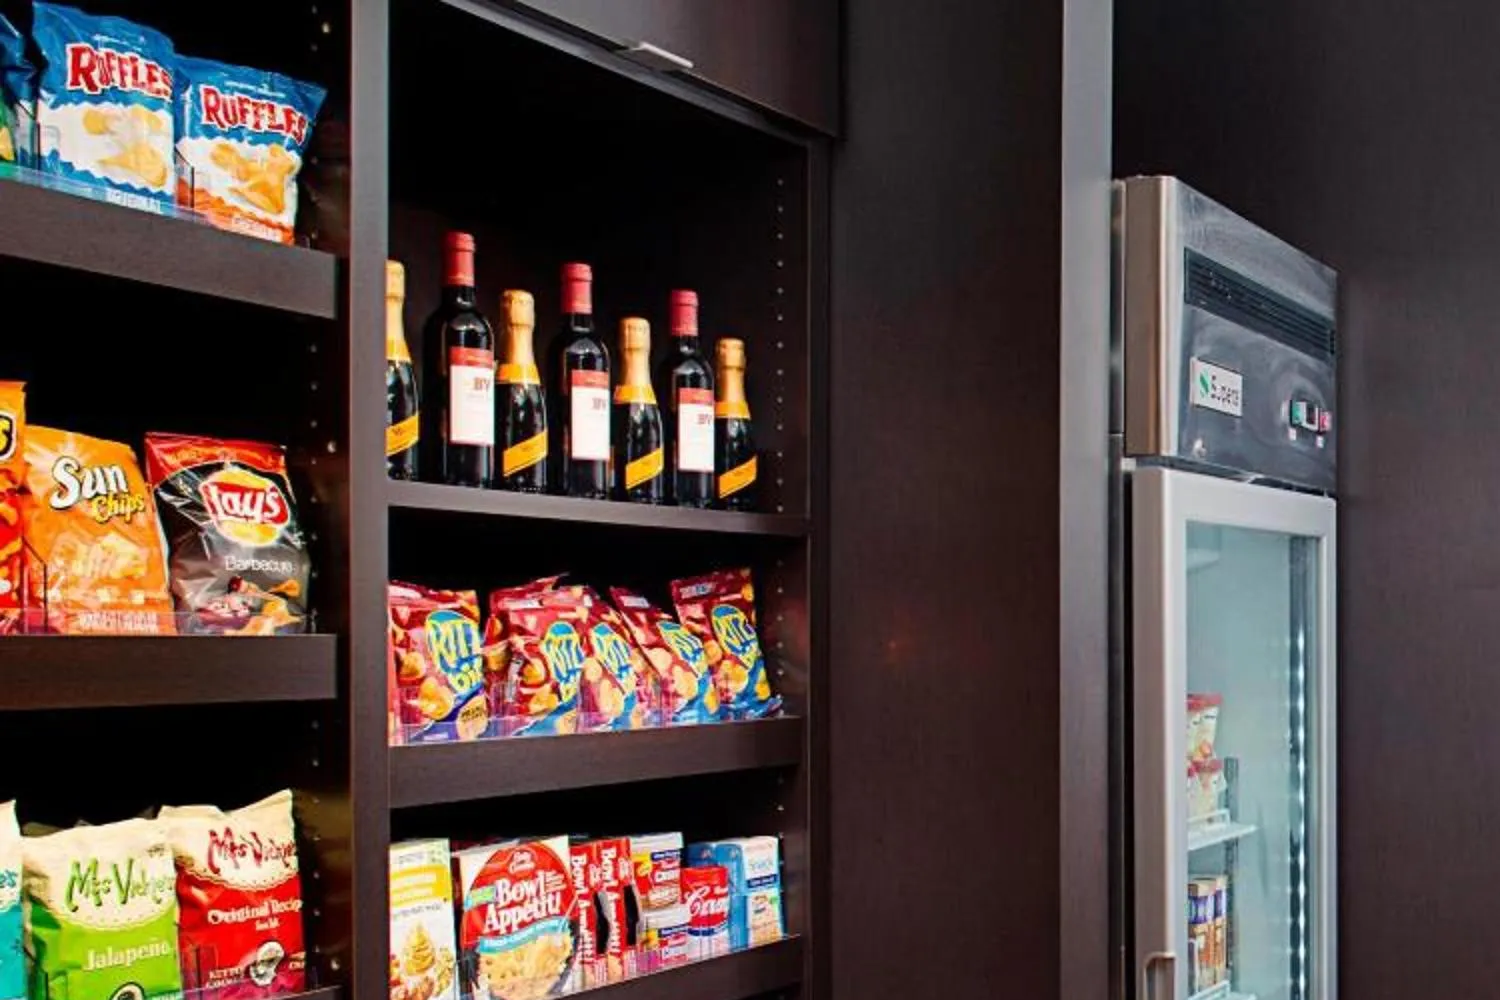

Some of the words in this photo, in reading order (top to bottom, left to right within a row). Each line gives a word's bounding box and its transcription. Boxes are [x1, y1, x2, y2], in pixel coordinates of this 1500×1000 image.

[67, 43, 173, 99] RUFFLES
[200, 84, 309, 144] RUFFLES
[50, 455, 129, 511] Sun
[91, 490, 146, 523] Chips
[494, 870, 546, 908] Bowl
